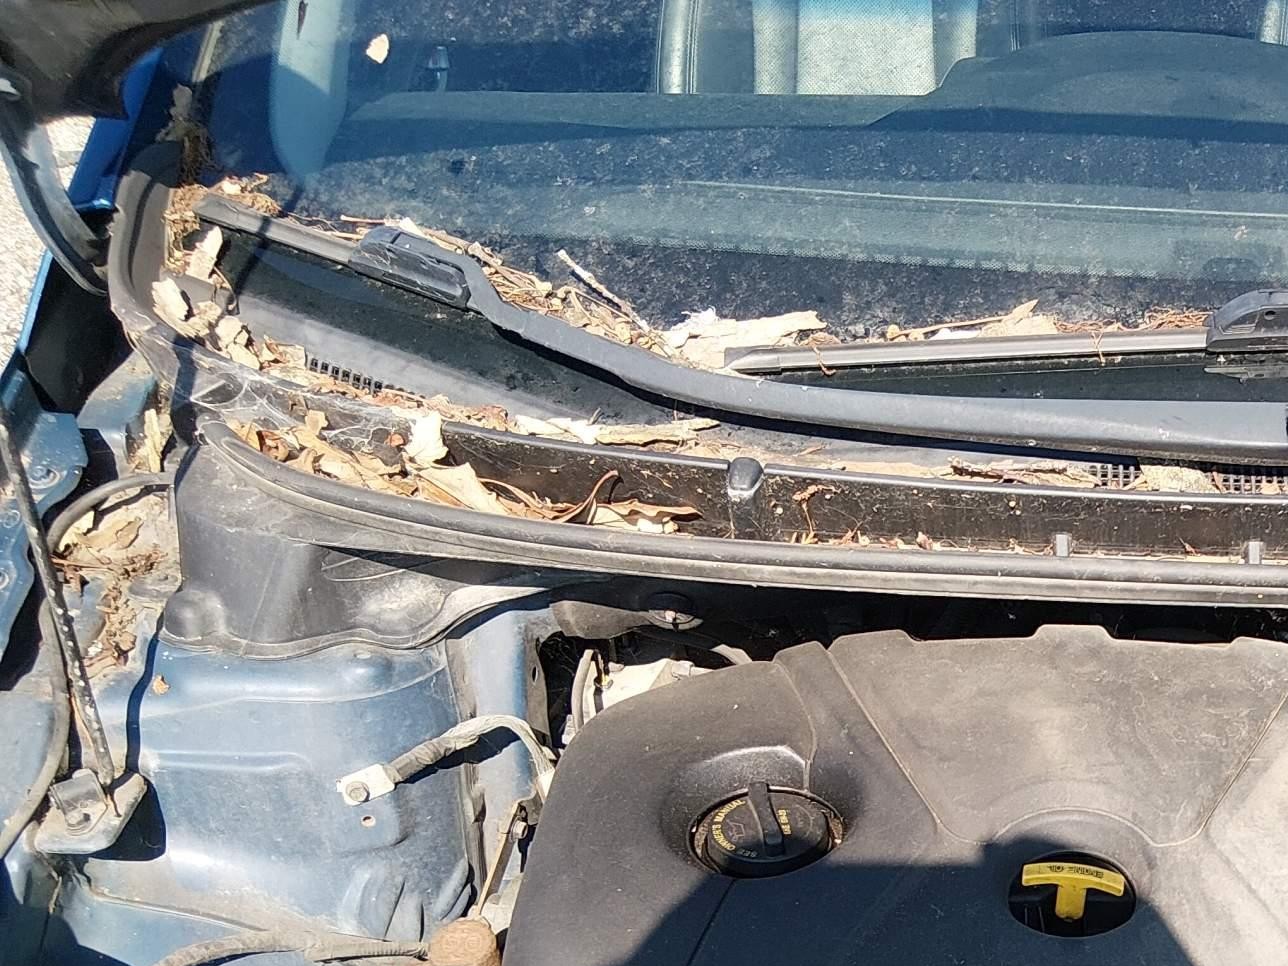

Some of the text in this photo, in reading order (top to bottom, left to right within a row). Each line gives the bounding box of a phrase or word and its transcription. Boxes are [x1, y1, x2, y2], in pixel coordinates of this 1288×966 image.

[714, 799, 746, 823] MANUAL
[711, 823, 737, 851] OWNER'S
[1047, 864, 1104, 879] ENGINE OIL
